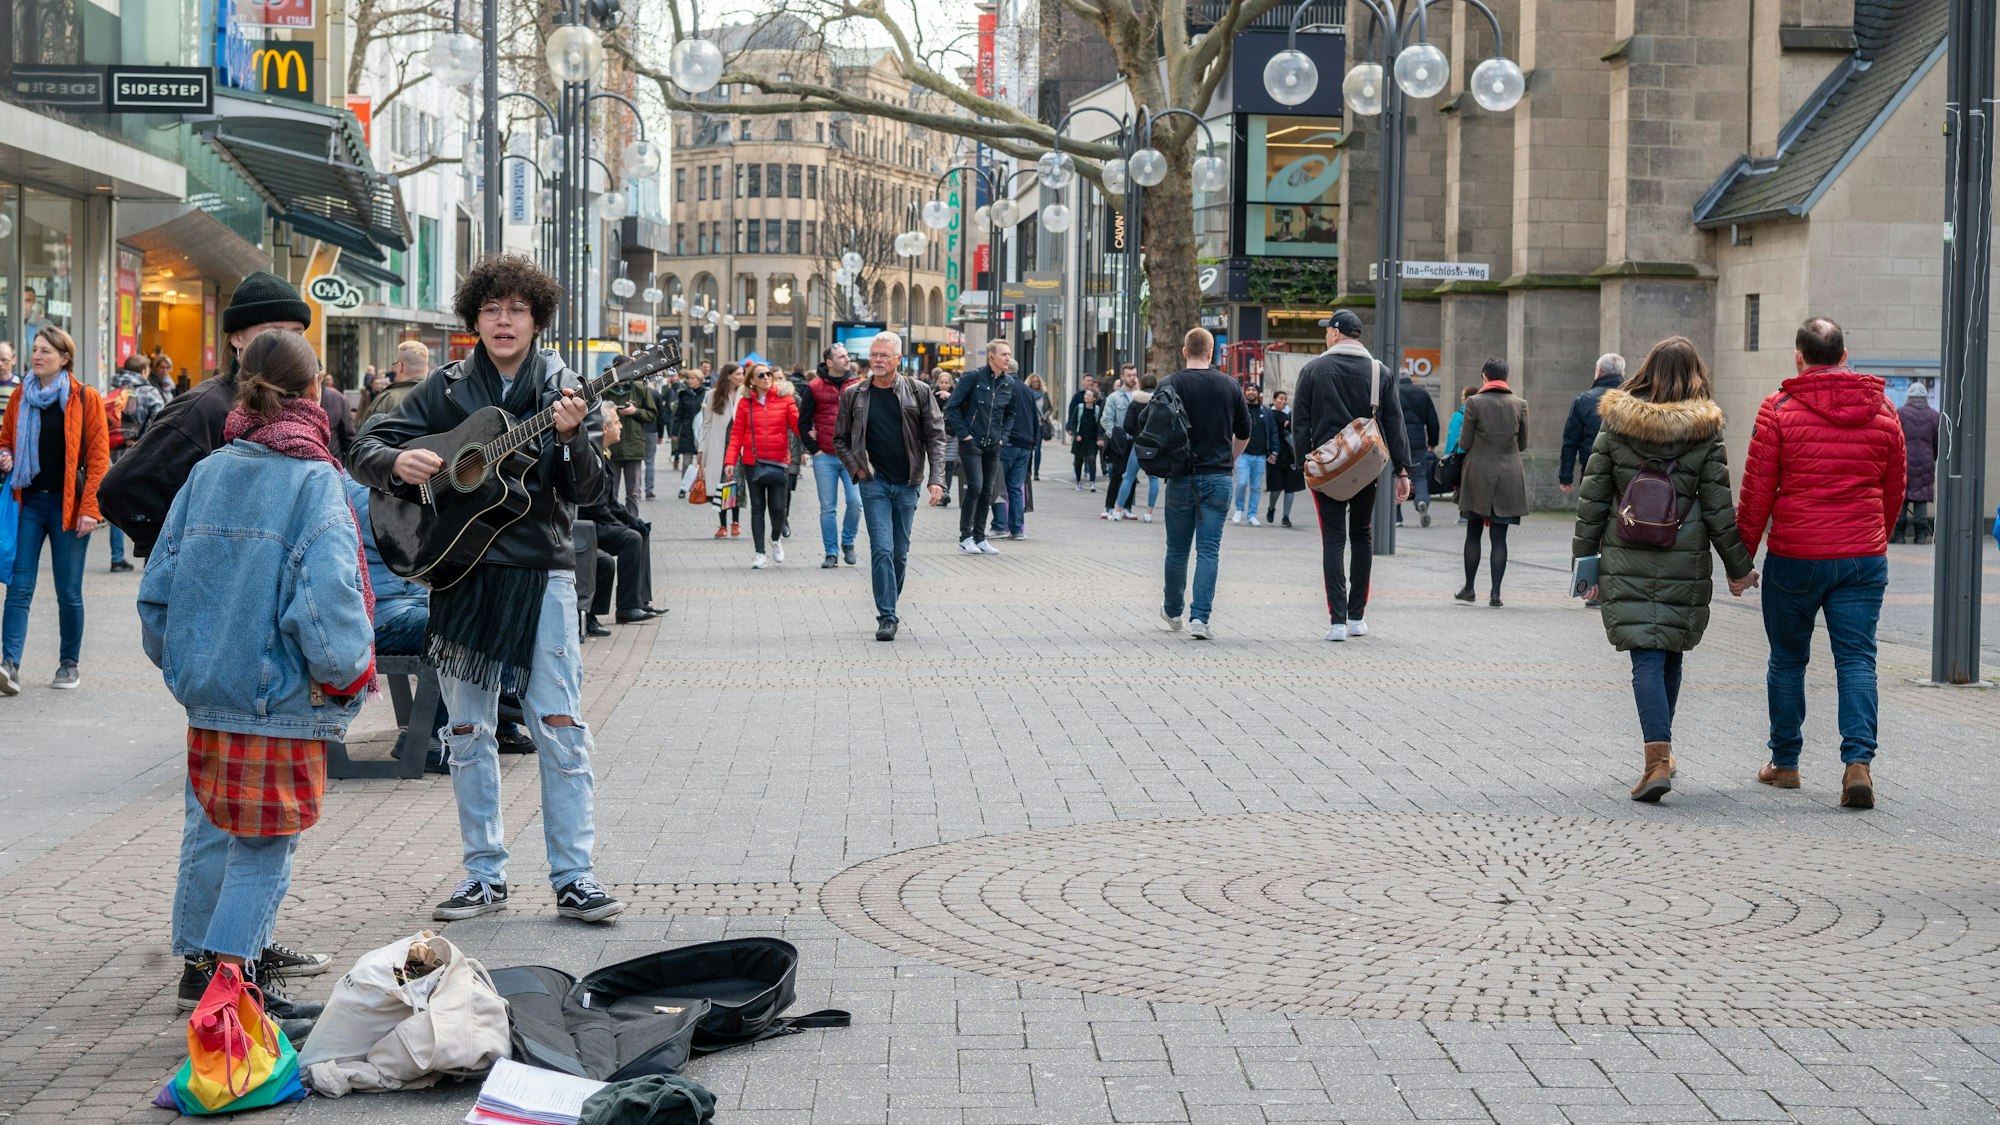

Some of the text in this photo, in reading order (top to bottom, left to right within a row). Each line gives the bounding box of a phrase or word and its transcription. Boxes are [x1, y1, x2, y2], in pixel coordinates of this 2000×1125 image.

[286, 15, 310, 25] ETAGE
[121, 83, 200, 96] SIDESTEP
[1114, 215, 1124, 249] CALVIN
[982, 247, 990, 272] sports
[314, 281, 342, 297] C&A
